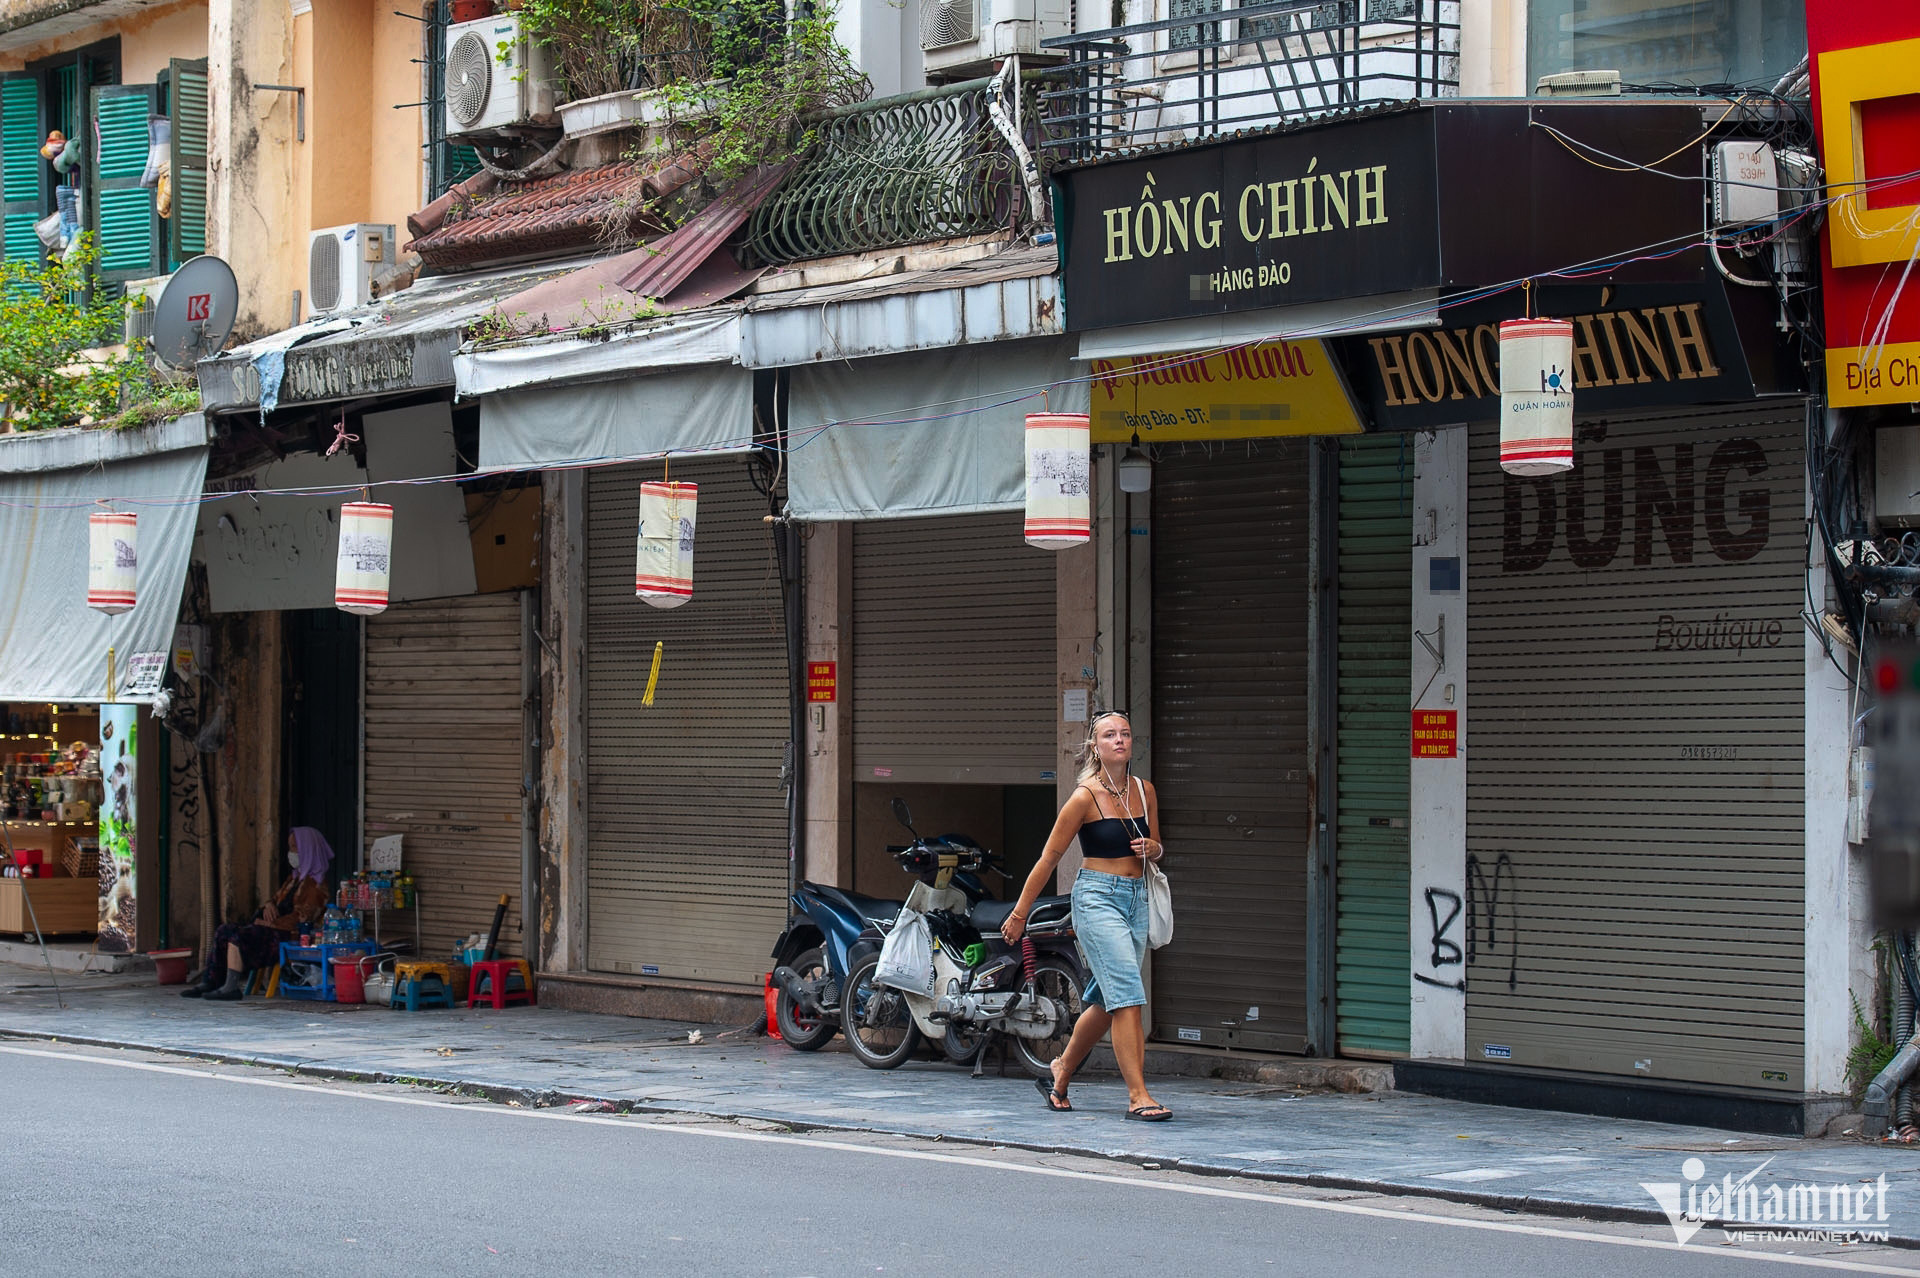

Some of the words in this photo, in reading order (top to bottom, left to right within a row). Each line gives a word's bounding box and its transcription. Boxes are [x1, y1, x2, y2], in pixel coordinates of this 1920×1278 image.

[1103, 171, 1223, 263] HỒNG
[1238, 156, 1389, 243] CHÍNH
[1258, 259, 1291, 287] ĐÀO
[1572, 286, 1721, 389] HÍNH
[1219, 341, 1314, 382] Minh
[1846, 362, 1881, 394] Địa
[1889, 356, 1920, 386] Ch
[1151, 409, 1178, 427] Đào
[1186, 408, 1210, 425] ĐT:
[1512, 401, 1539, 412] QUẬN
[1502, 419, 1770, 573] DŨNG
[1655, 612, 1783, 657] Boutique
